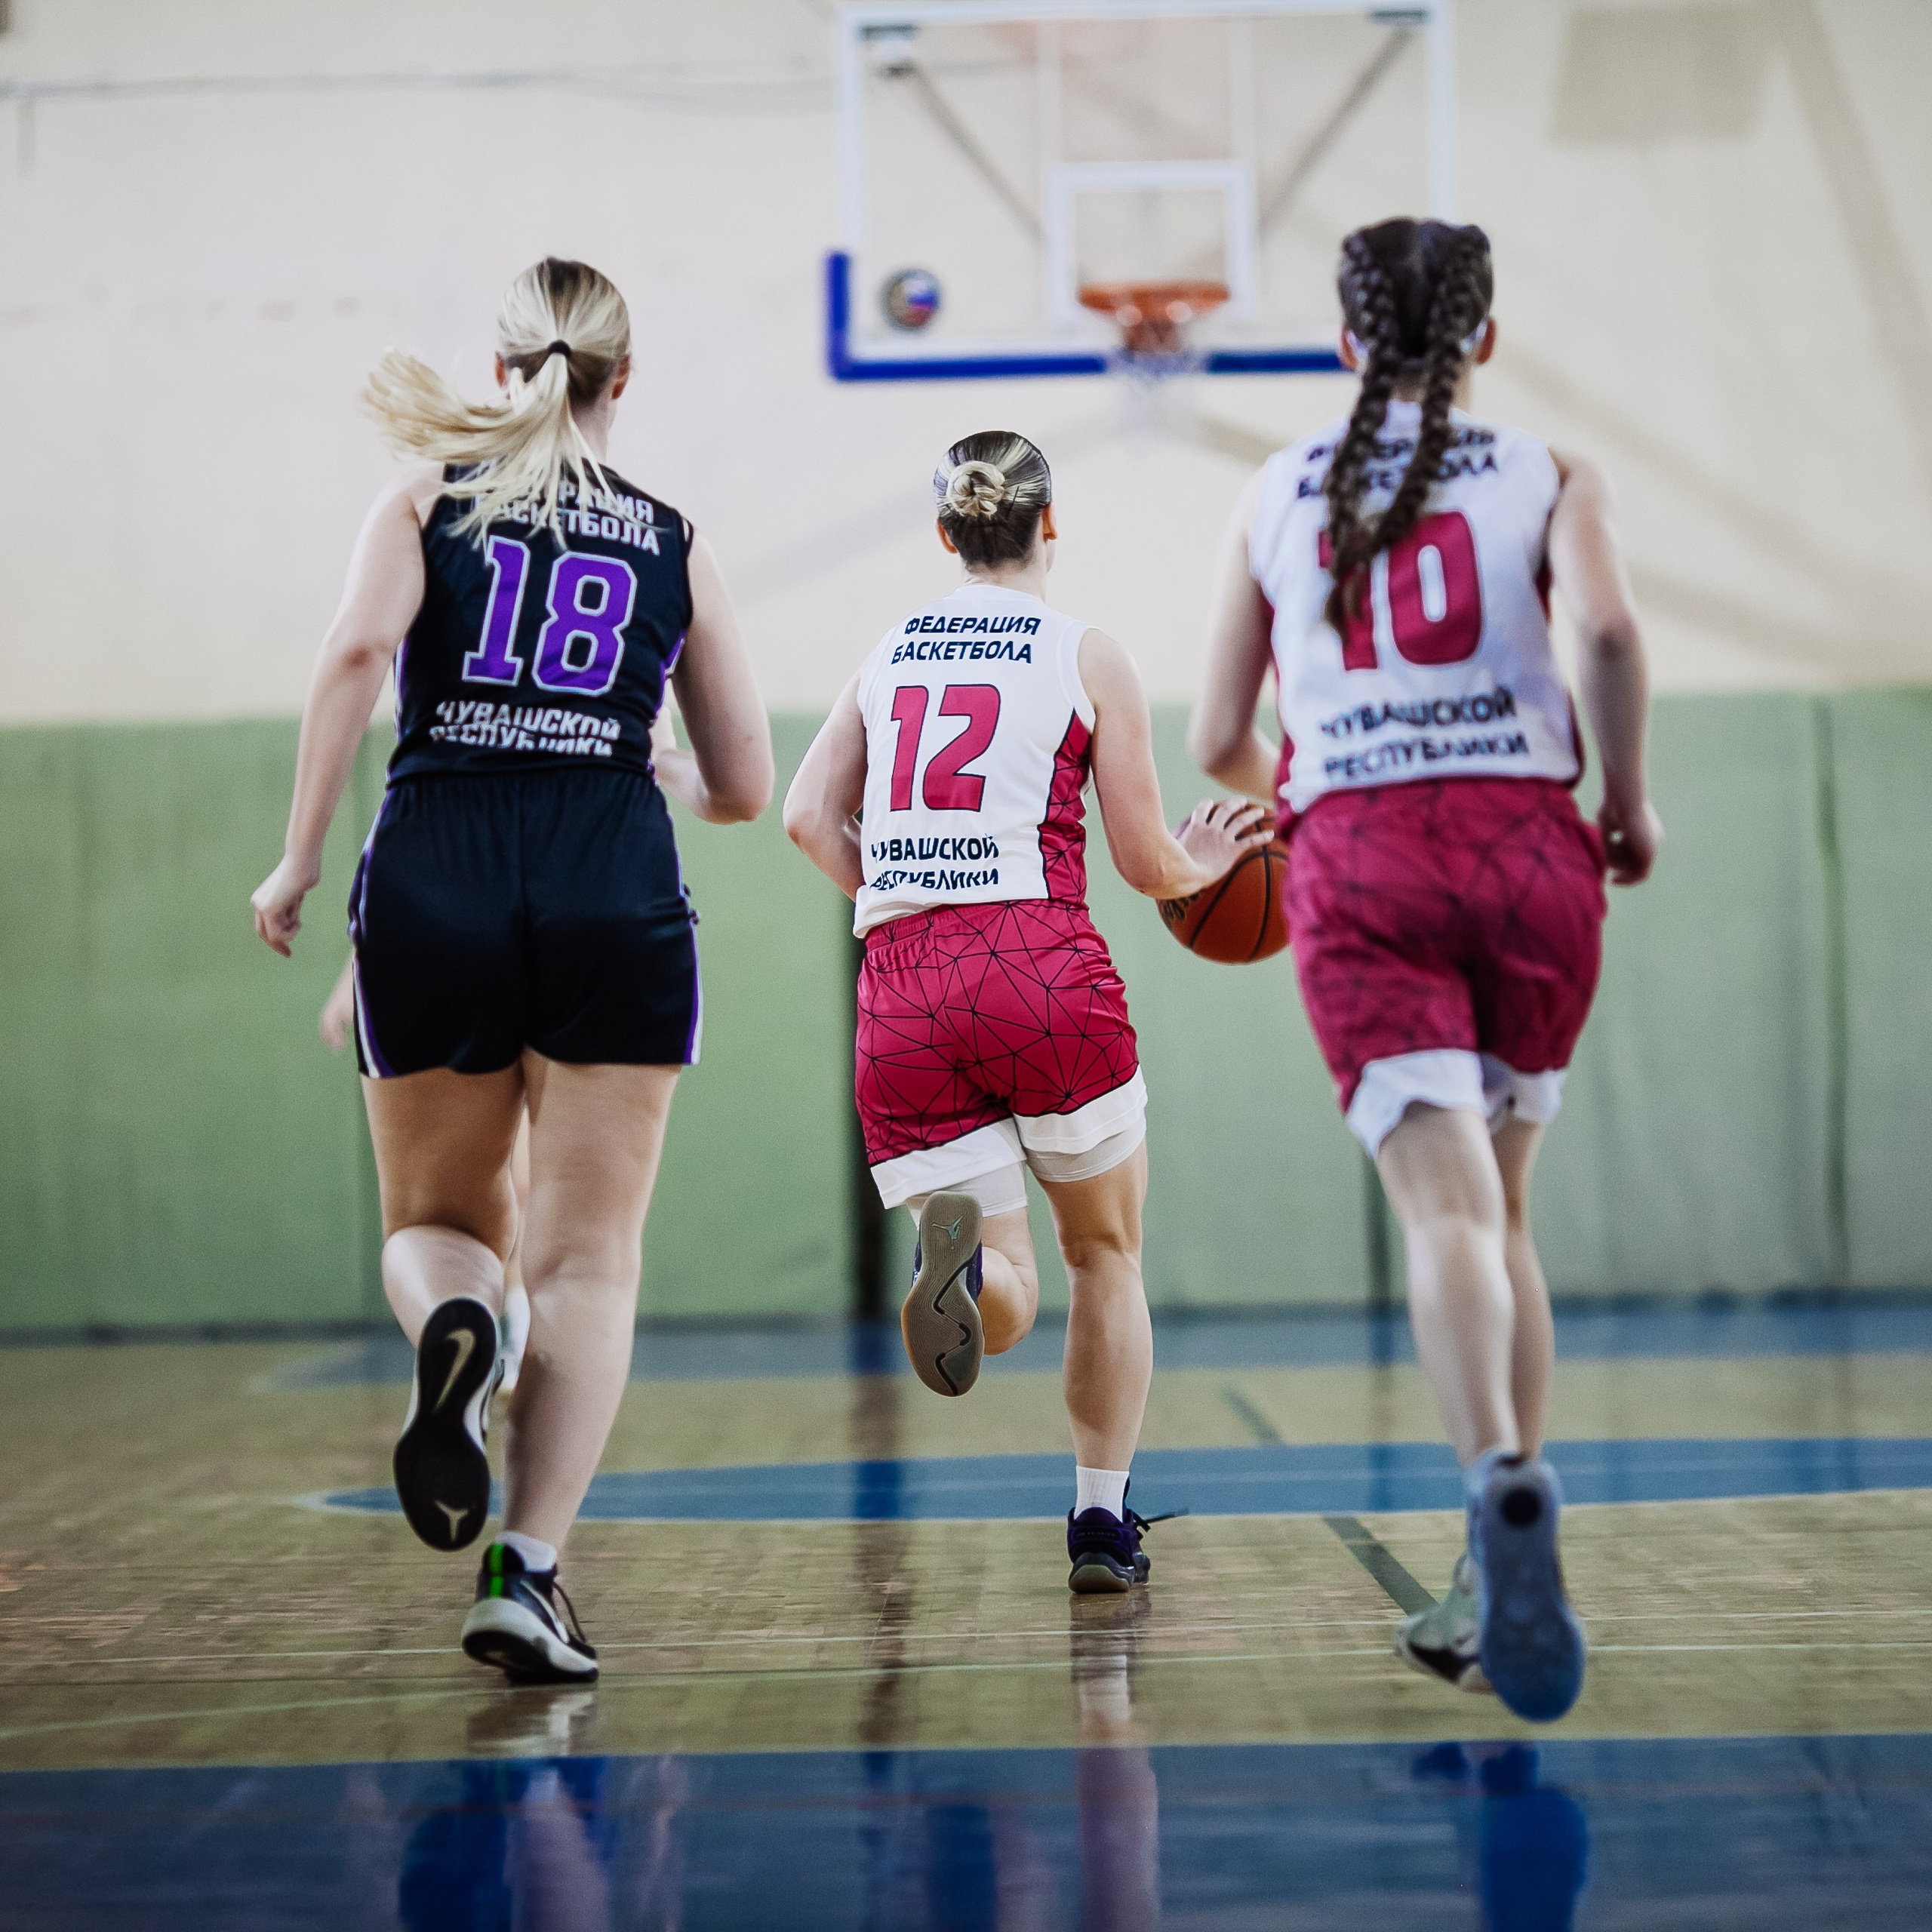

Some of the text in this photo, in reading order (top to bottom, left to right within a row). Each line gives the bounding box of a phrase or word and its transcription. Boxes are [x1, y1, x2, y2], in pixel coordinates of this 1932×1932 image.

[463, 535, 638, 697] 18
[904, 615, 1041, 635] ФЕДЕРАЦИЯ
[891, 640, 1032, 664] БАСКЕТБОЛА
[890, 683, 1001, 812] 12
[871, 832, 999, 863] ЧУВАШСКОЙ
